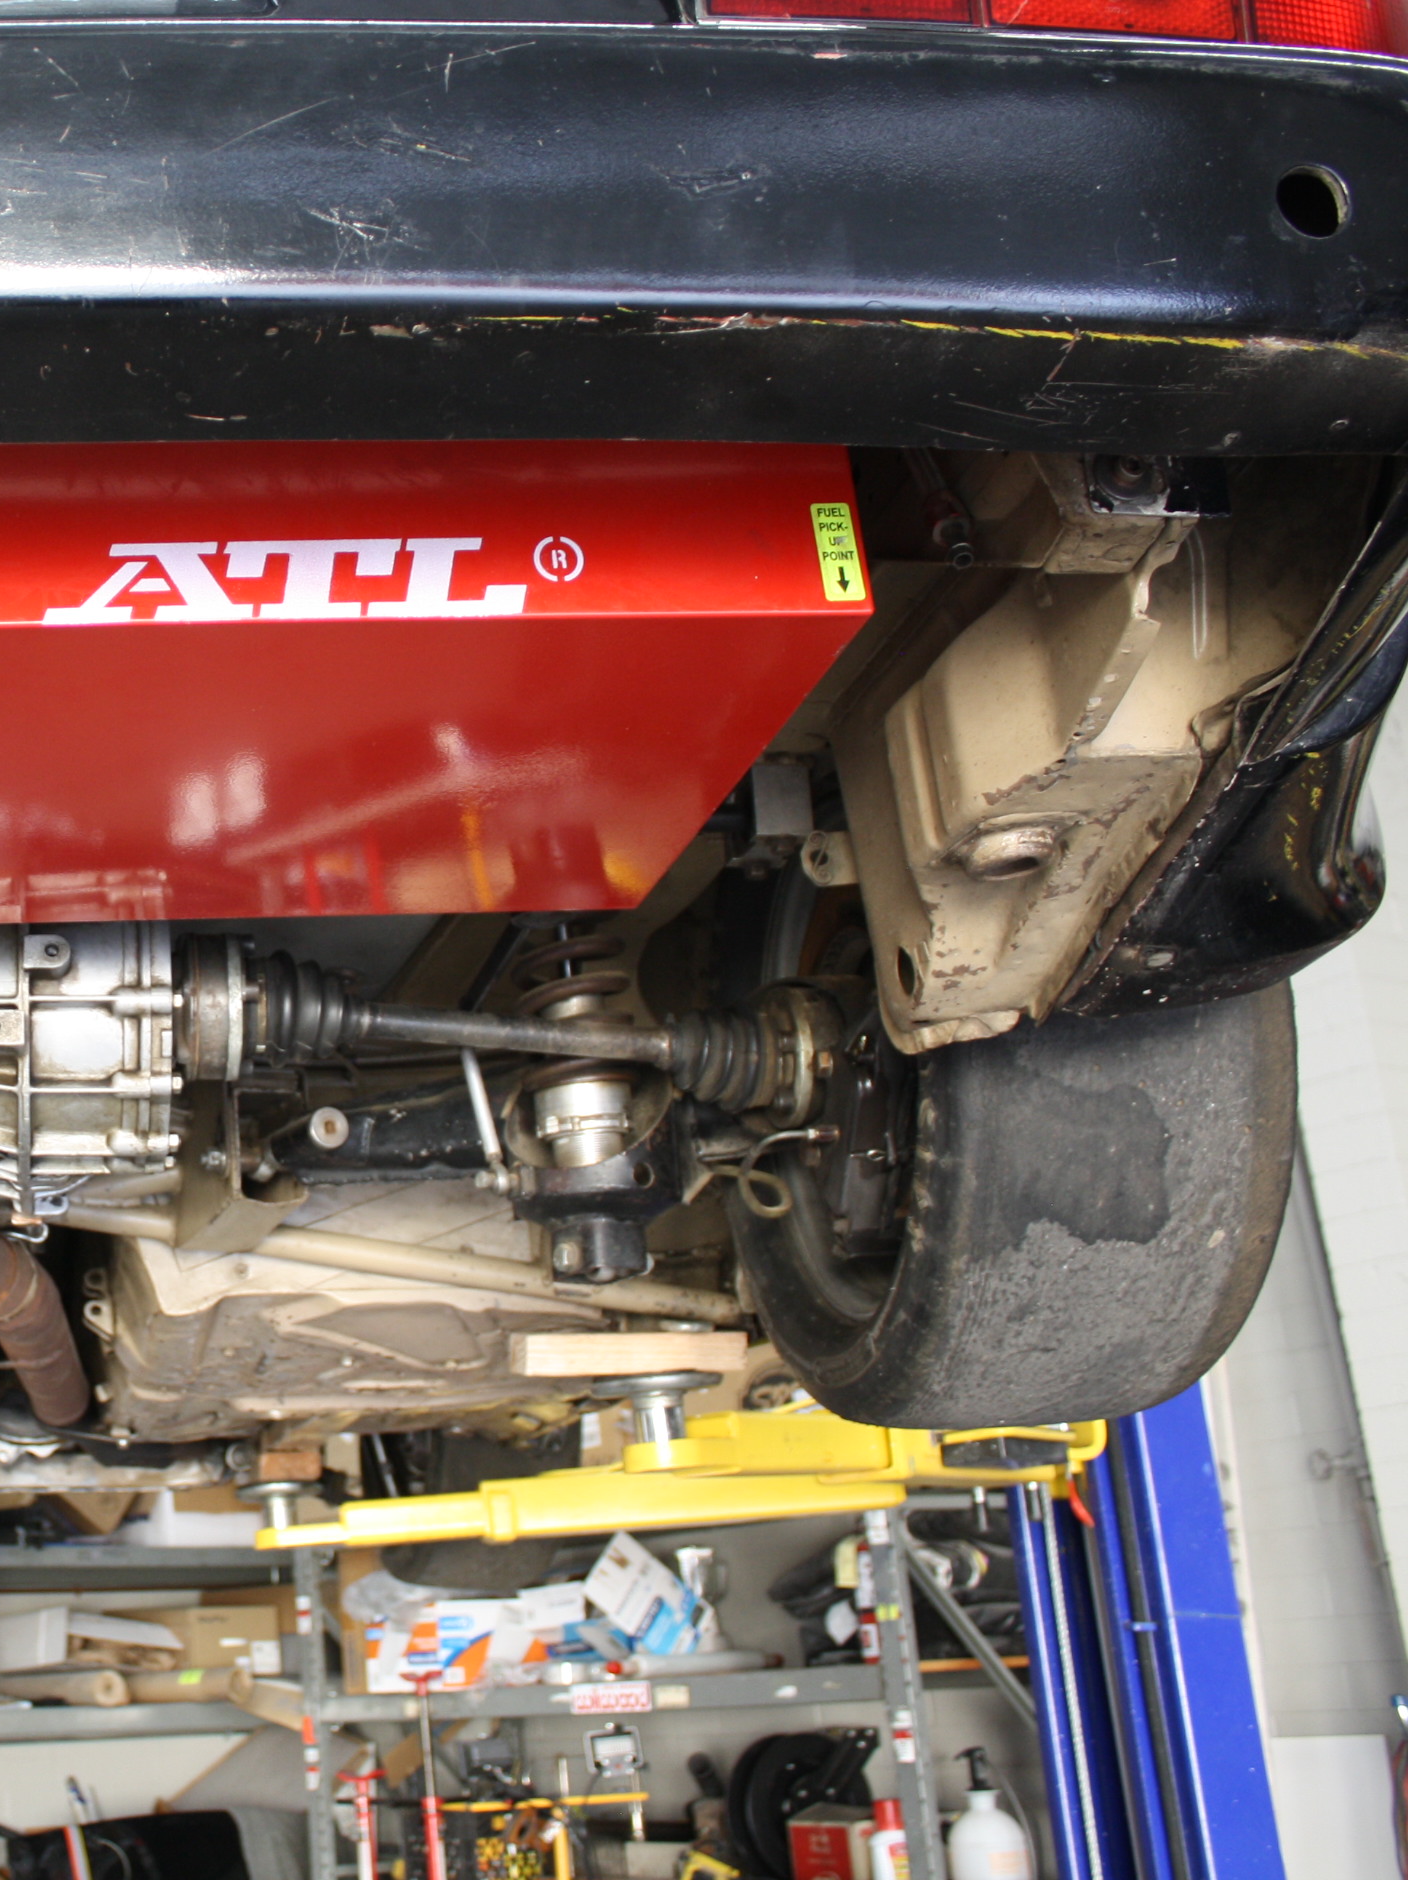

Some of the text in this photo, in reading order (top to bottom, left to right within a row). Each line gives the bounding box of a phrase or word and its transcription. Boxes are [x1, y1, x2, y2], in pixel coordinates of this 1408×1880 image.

[816, 507, 846, 518] FUEL
[818, 522, 849, 532] PICK-
[821, 550, 855, 561] POINT
[42, 537, 528, 625] ATL
